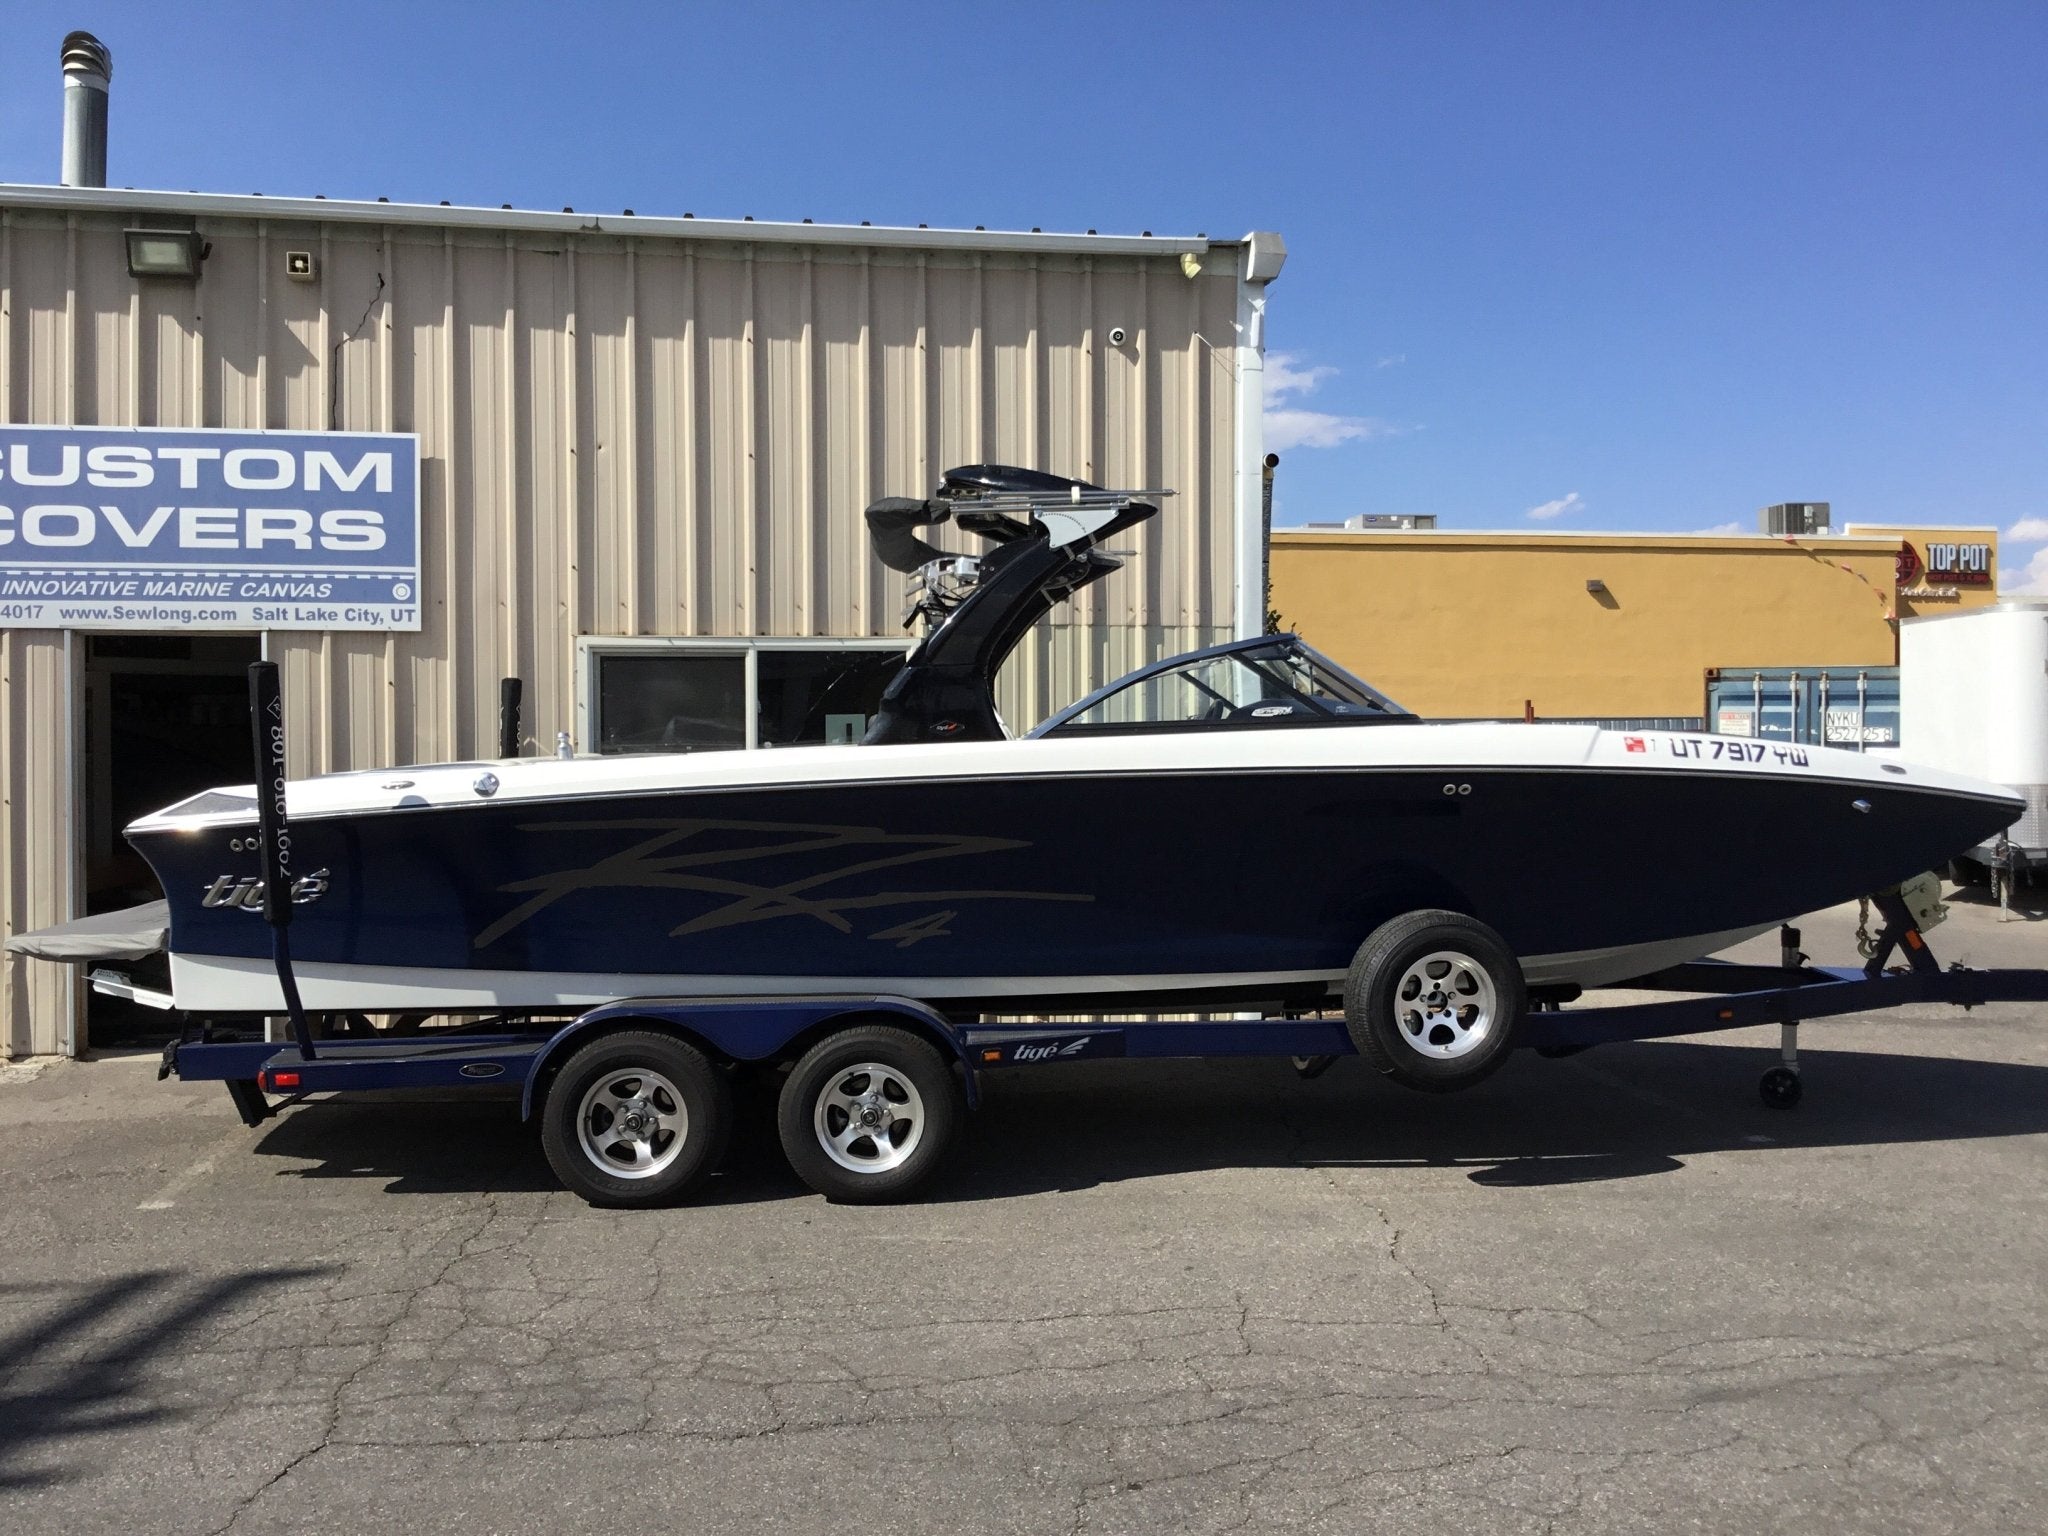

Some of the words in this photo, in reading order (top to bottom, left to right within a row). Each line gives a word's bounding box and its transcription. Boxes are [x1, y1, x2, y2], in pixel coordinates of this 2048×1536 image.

[0, 444, 393, 493] USTOM
[0, 505, 387, 551] OVERS
[1928, 544, 1957, 571] TOP
[1960, 544, 1988, 571] POT
[1, 580, 139, 596] INNOVATIVE
[143, 581, 233, 597] MARINE
[240, 583, 332, 598] CANVAS
[59, 606, 237, 623] www.Sewlong.com
[252, 607, 288, 621] Salt
[295, 608, 338, 621] Lake
[344, 608, 384, 625] City,
[391, 609, 416, 622] UT
[1827, 712, 1859, 726] NYKU
[1670, 738, 1702, 759] UT
[1710, 741, 1765, 763] 7917
[1772, 746, 1809, 767] YW
